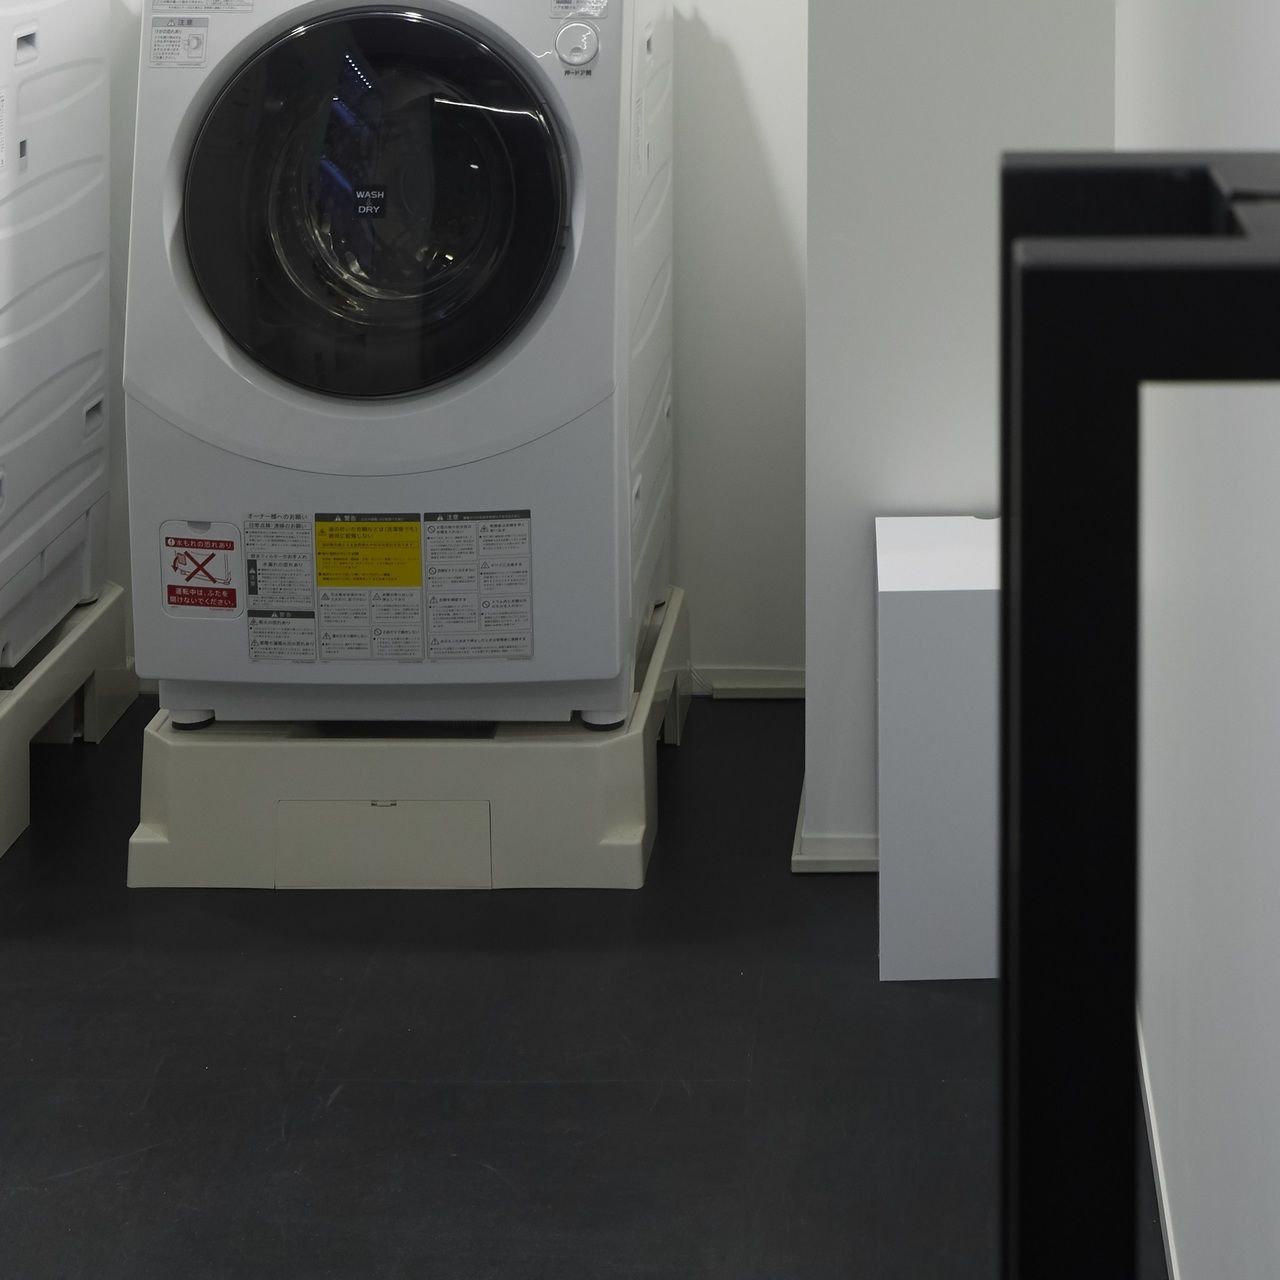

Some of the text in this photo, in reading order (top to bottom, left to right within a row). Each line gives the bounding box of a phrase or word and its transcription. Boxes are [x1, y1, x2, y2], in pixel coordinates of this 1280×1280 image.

[356, 191, 385, 199] WASH
[176, 540, 232, 550] 水もれの恐れあり
[175, 589, 229, 597] 運転中は、ふたを
[170, 597, 235, 606] 開けないでください。
